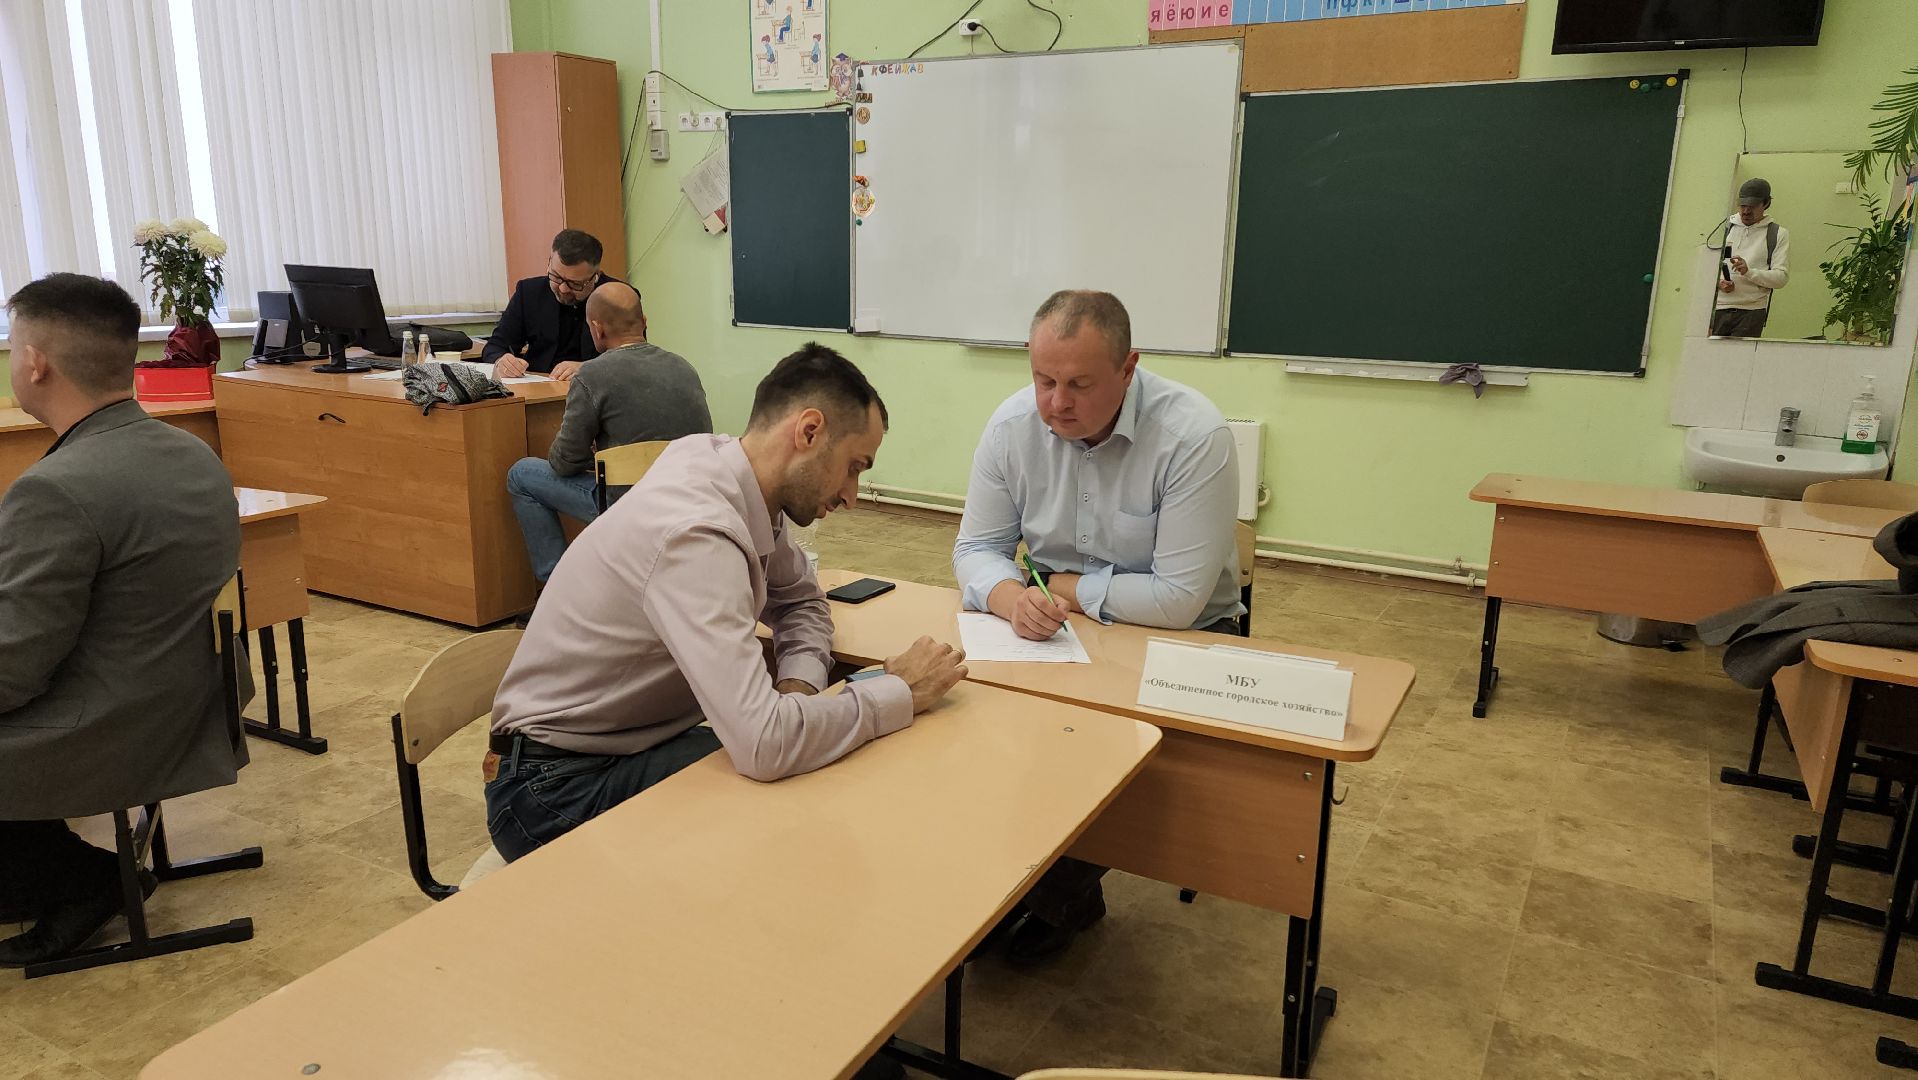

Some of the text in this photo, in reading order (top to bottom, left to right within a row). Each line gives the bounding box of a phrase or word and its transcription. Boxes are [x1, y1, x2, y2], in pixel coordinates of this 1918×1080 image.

[1226, 674, 1261, 689] МБУ
[1144, 677, 1343, 718] «Объединенное городское хозяйство»
